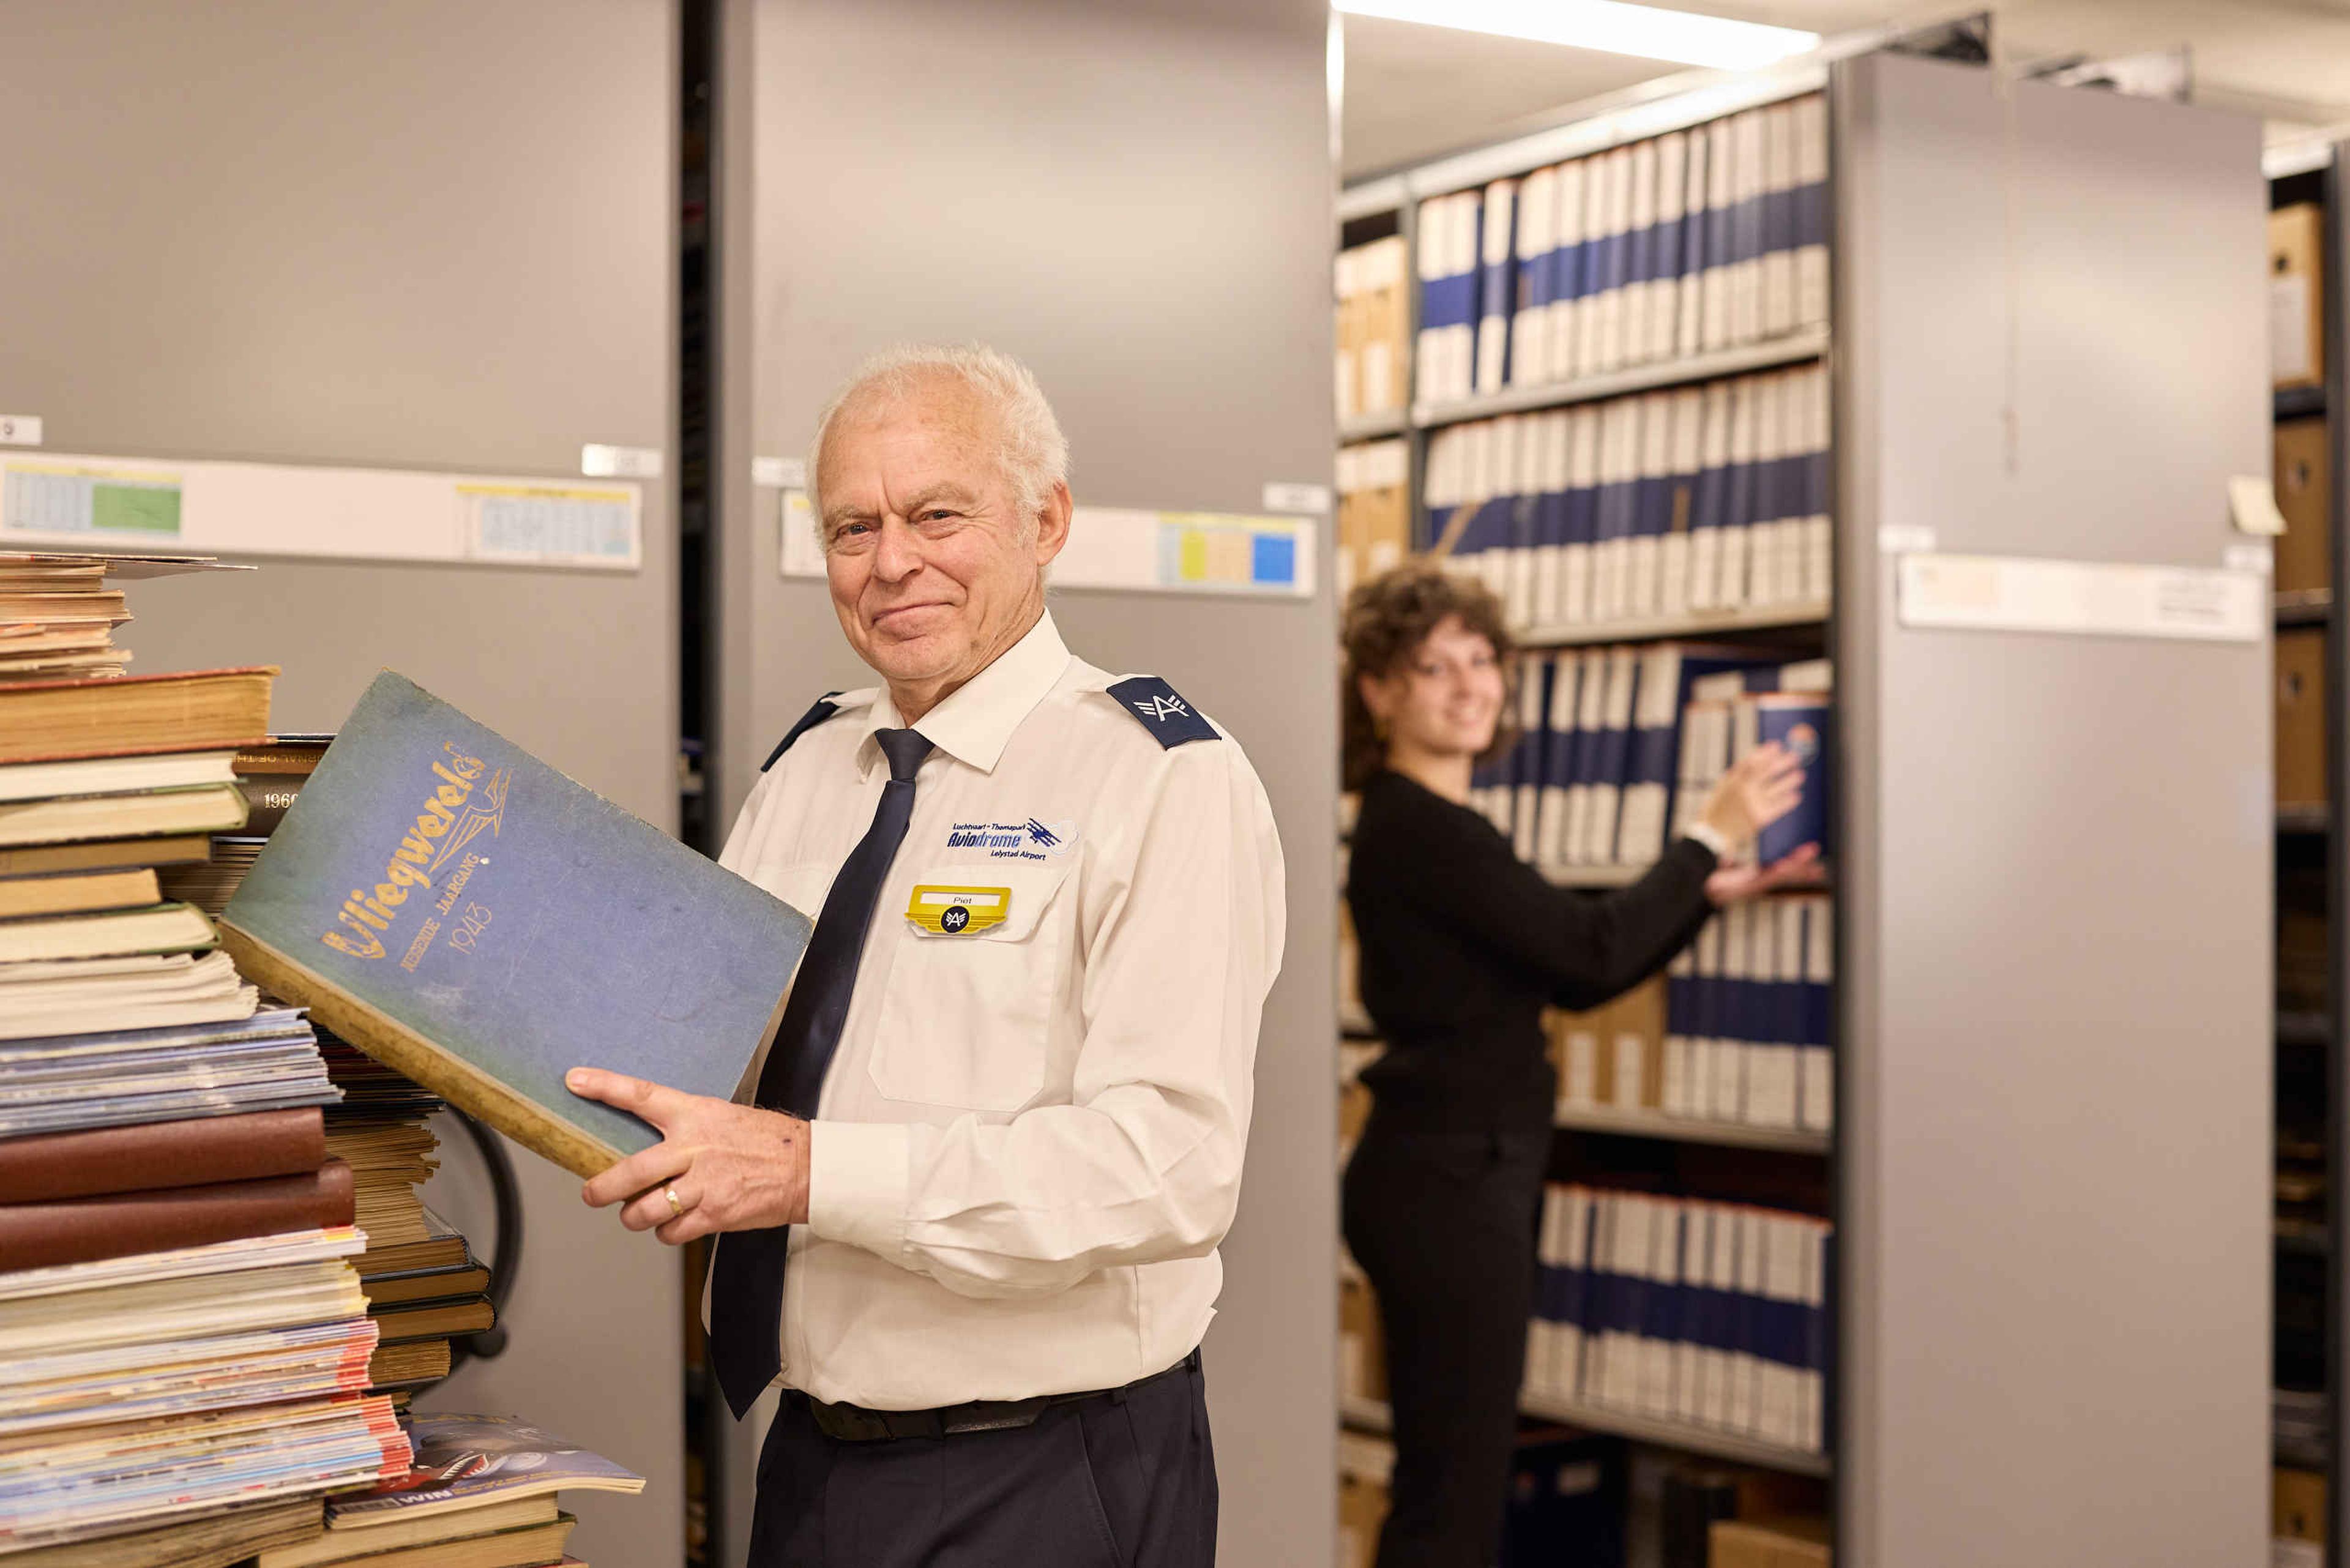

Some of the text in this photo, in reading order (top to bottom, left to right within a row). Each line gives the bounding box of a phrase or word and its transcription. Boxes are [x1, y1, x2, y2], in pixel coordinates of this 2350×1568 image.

[320, 741, 486, 960] Vliegwereld
[947, 832, 1021, 848] Aviodrome
[990, 849, 1046, 861] Lelystad Airport
[435, 852, 480, 916] JAARGANG
[447, 901, 493, 955] 1943
[400, 1488, 453, 1506] WIN
